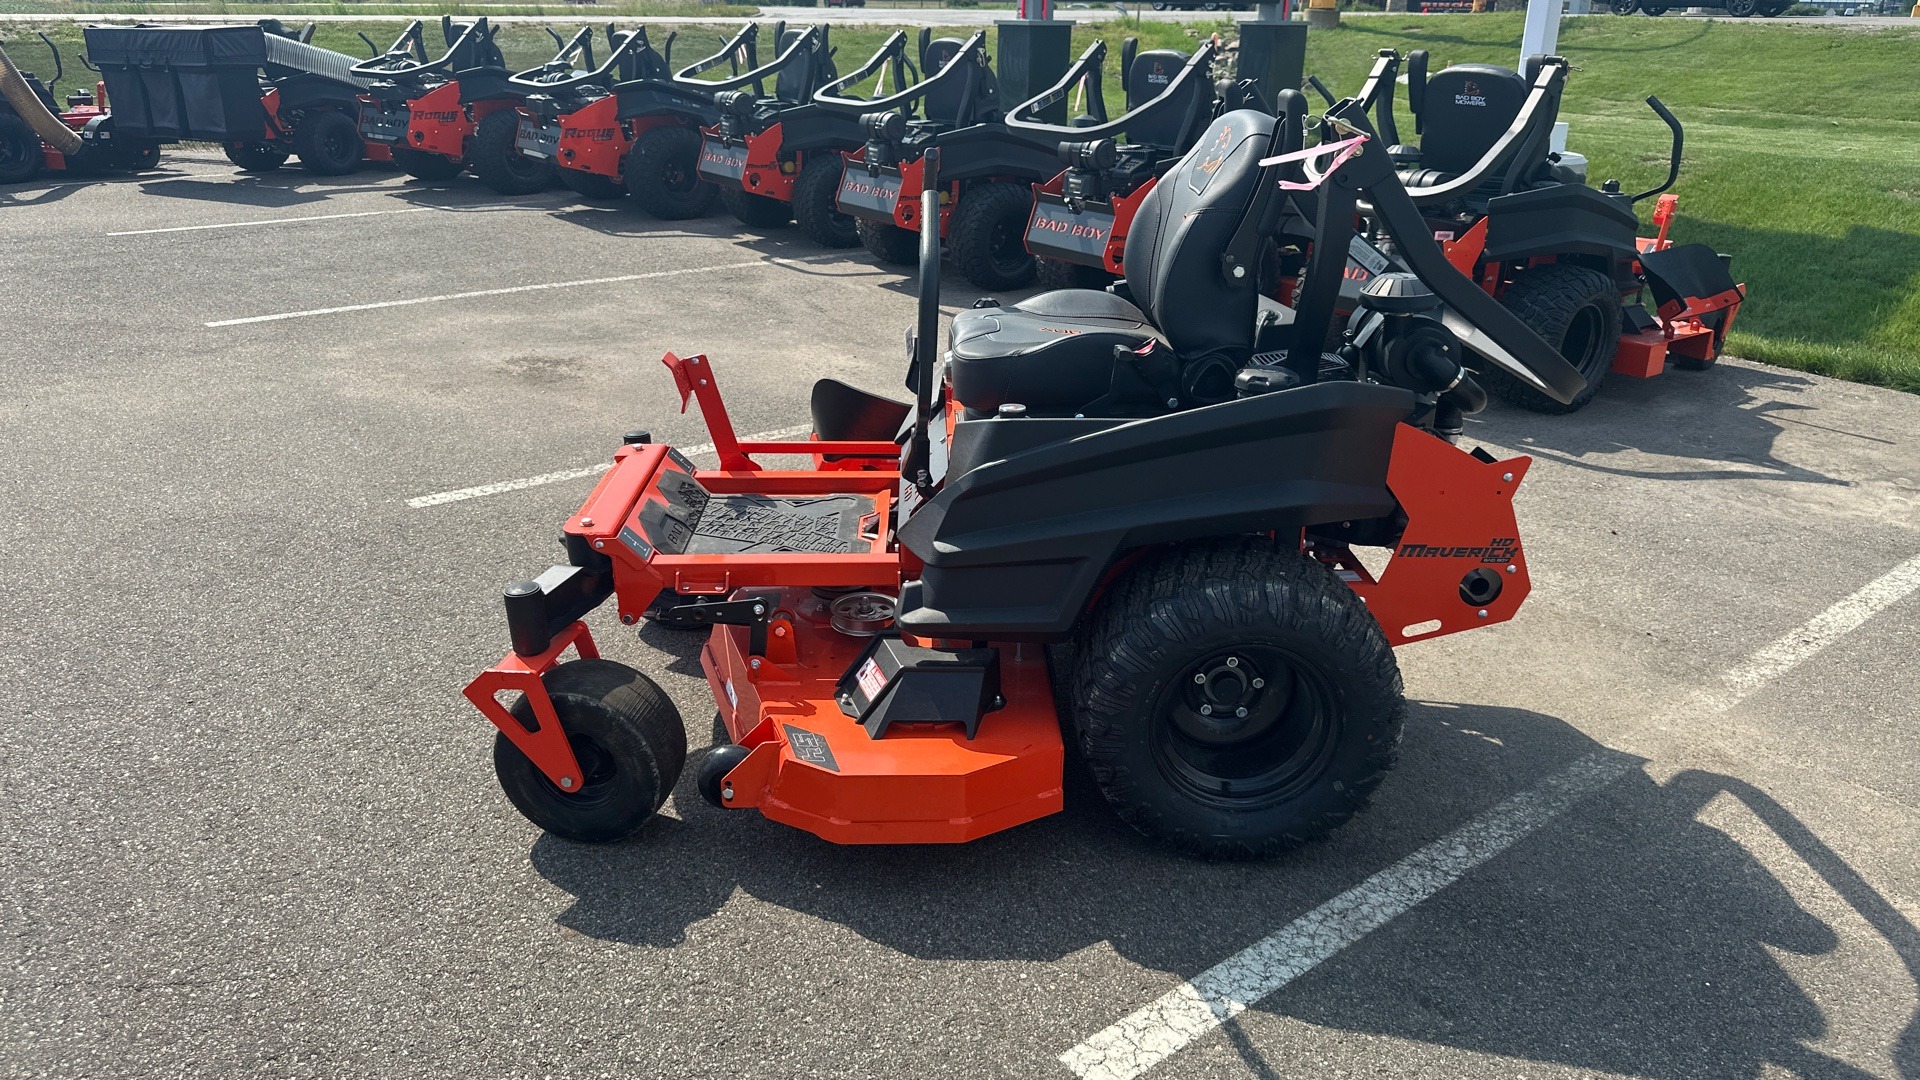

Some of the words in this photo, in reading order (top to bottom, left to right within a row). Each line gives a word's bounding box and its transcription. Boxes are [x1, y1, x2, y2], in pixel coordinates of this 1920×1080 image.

[362, 115, 383, 125] BAD
[520, 129, 538, 140] BAD
[540, 133, 560, 144] BOY
[704, 152, 723, 164] BAD
[724, 156, 744, 168] BOY
[844, 181, 869, 194] BAD
[871, 186, 897, 200] BOY
[1035, 217, 1068, 233] BAD
[1071, 224, 1106, 240] BOY
[1343, 266, 1369, 281] AD
[668, 522, 684, 545] BAD
[1490, 538, 1515, 547] HD
[1398, 544, 1518, 557] MAVERICK
